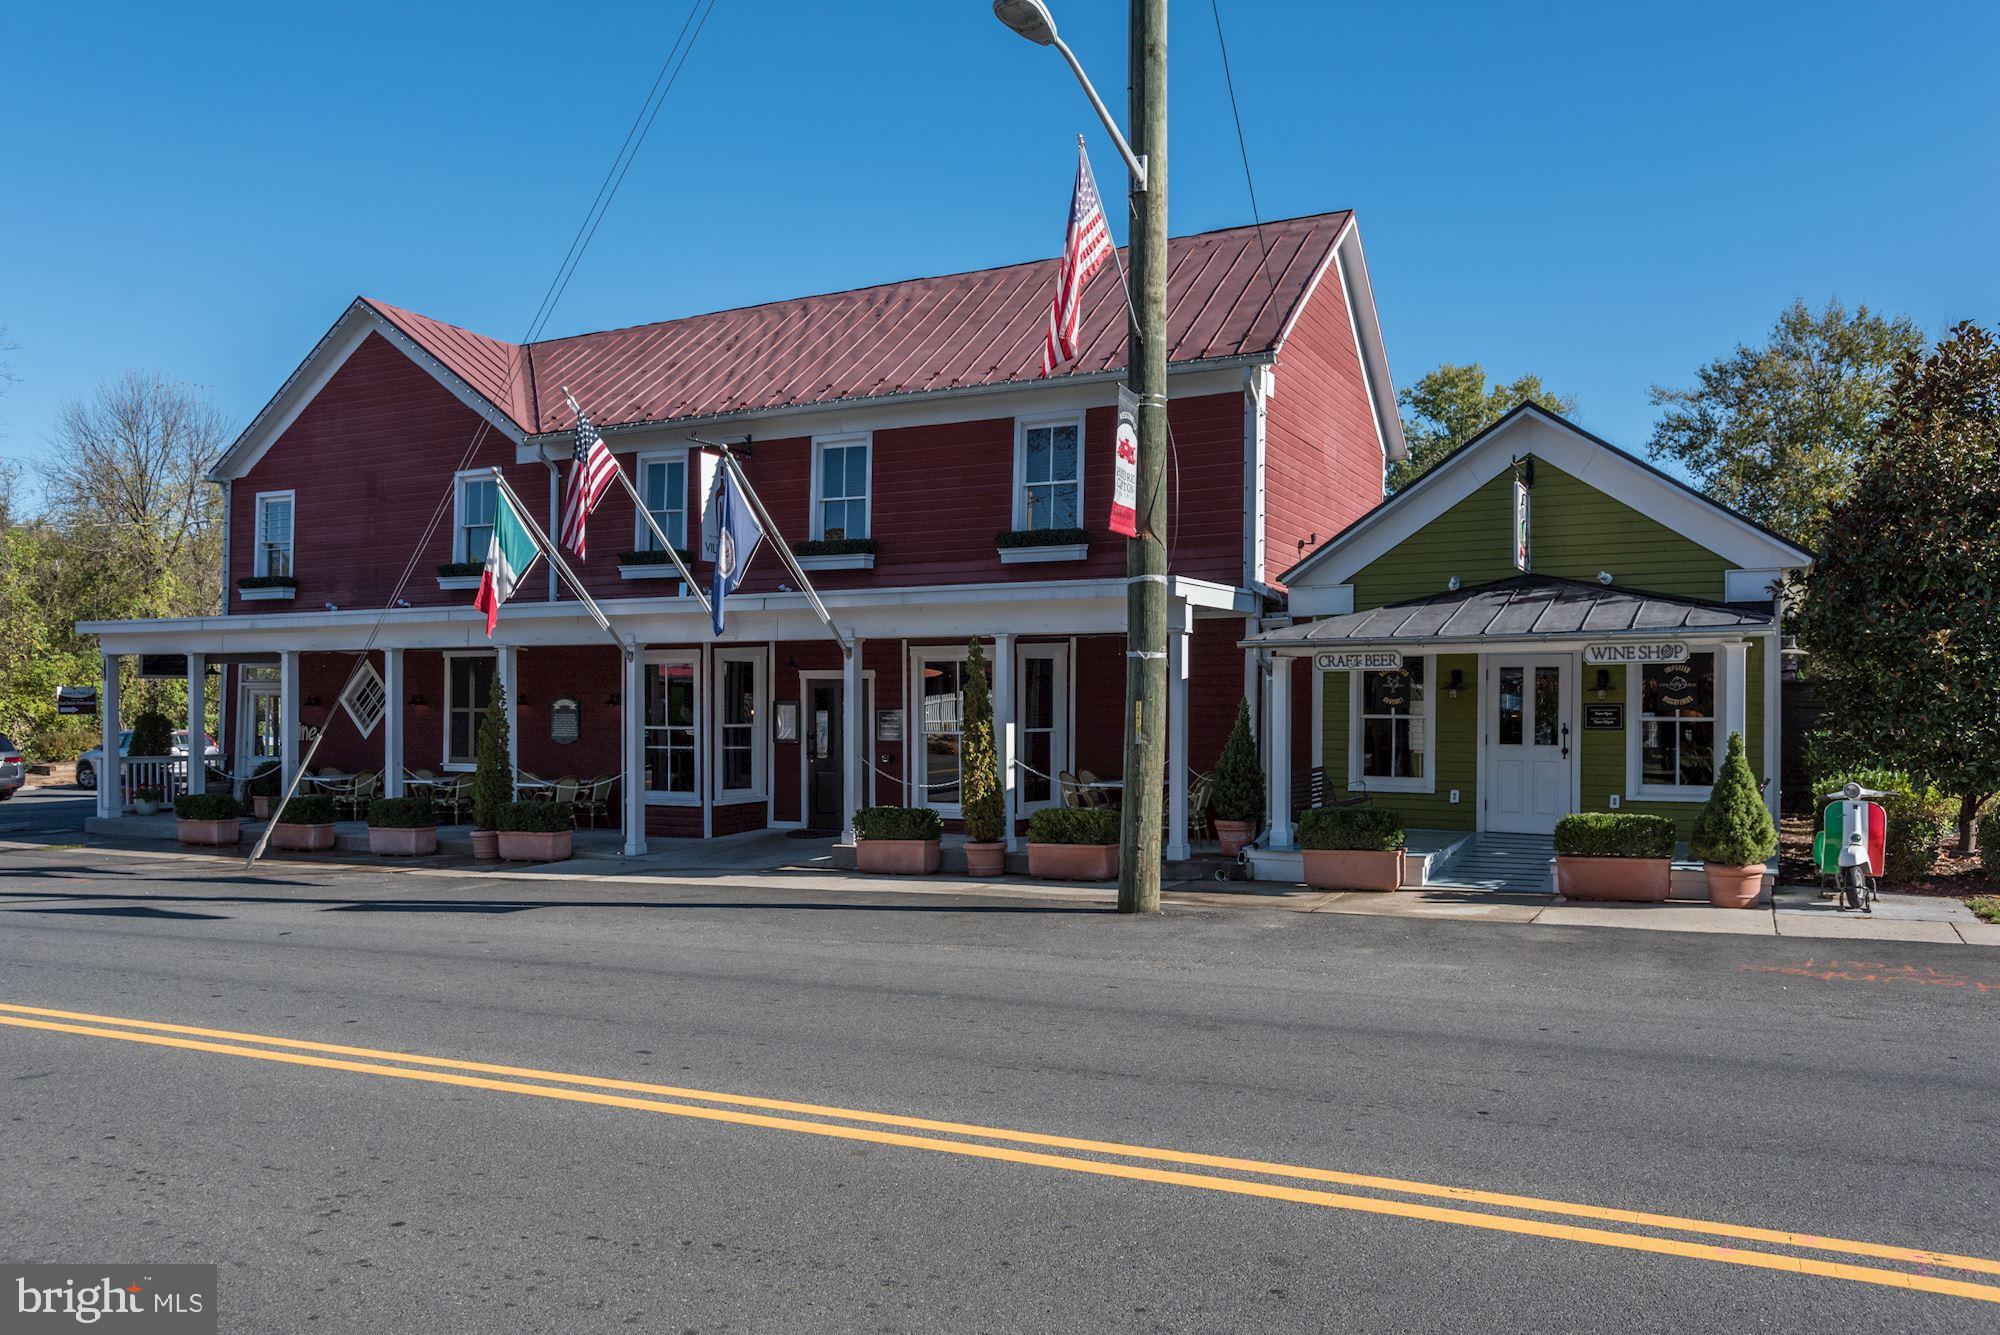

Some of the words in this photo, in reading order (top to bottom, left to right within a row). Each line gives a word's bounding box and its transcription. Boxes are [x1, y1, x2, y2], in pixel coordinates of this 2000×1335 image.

[1590, 646, 1635, 660] WINE
[1638, 644, 1683, 660] SHOP
[1318, 655, 1362, 668] CRAFT
[1364, 654, 1397, 667] BEER
[298, 721, 318, 741] ine
